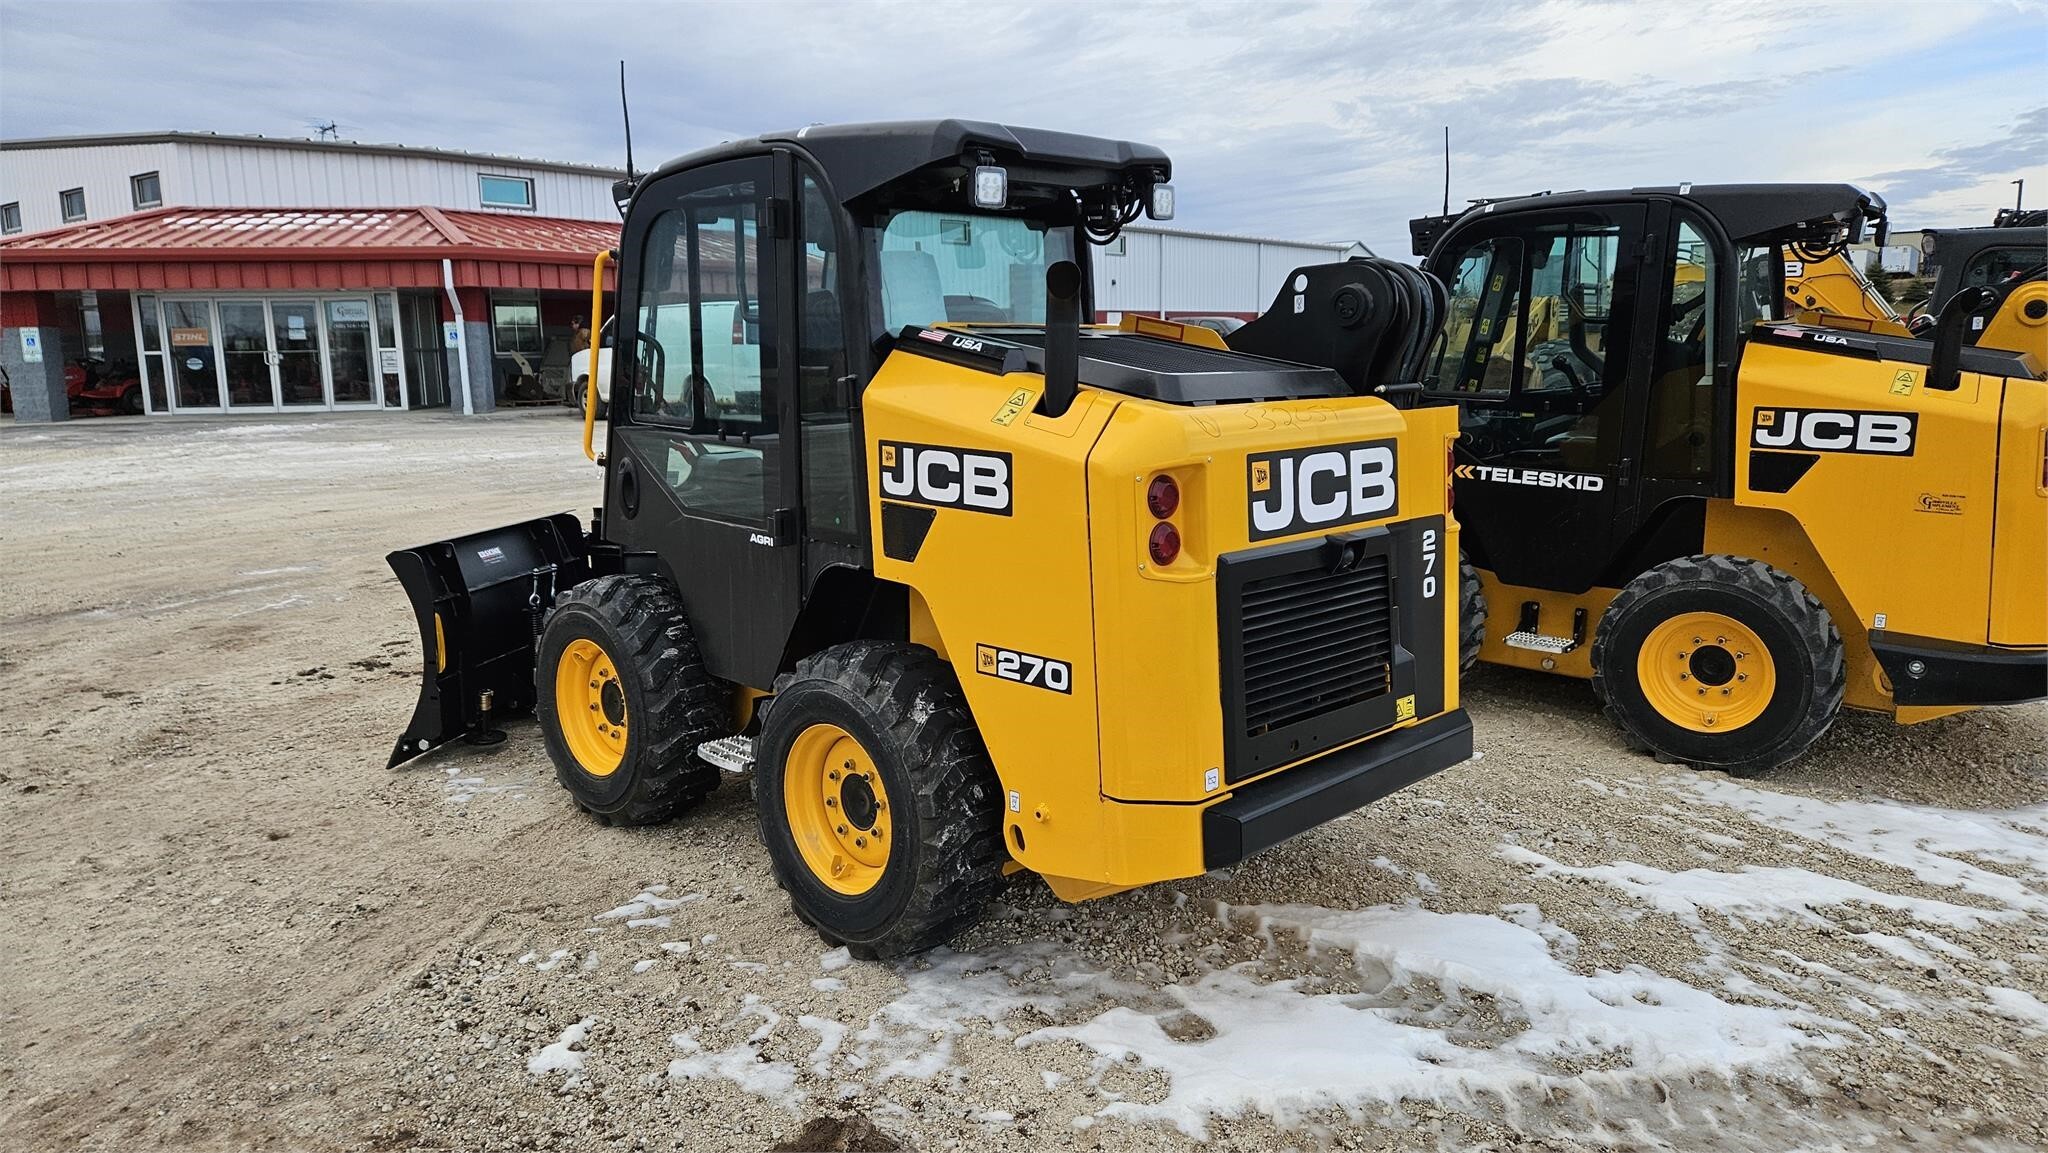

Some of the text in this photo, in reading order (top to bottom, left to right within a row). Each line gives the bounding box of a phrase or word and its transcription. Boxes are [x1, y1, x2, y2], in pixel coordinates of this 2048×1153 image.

[175, 333, 206, 341] STIHL
[952, 338, 983, 352] USA
[1813, 334, 1848, 345] USA
[1755, 411, 1912, 452] JCB
[882, 447, 1010, 509] JCB
[1252, 446, 1396, 532] JCB
[1256, 468, 1268, 484] JCB
[1476, 465, 1604, 492] TELESKID
[750, 533, 774, 547] AGRI
[1422, 529, 1436, 598] 270
[998, 651, 1068, 691] 270
